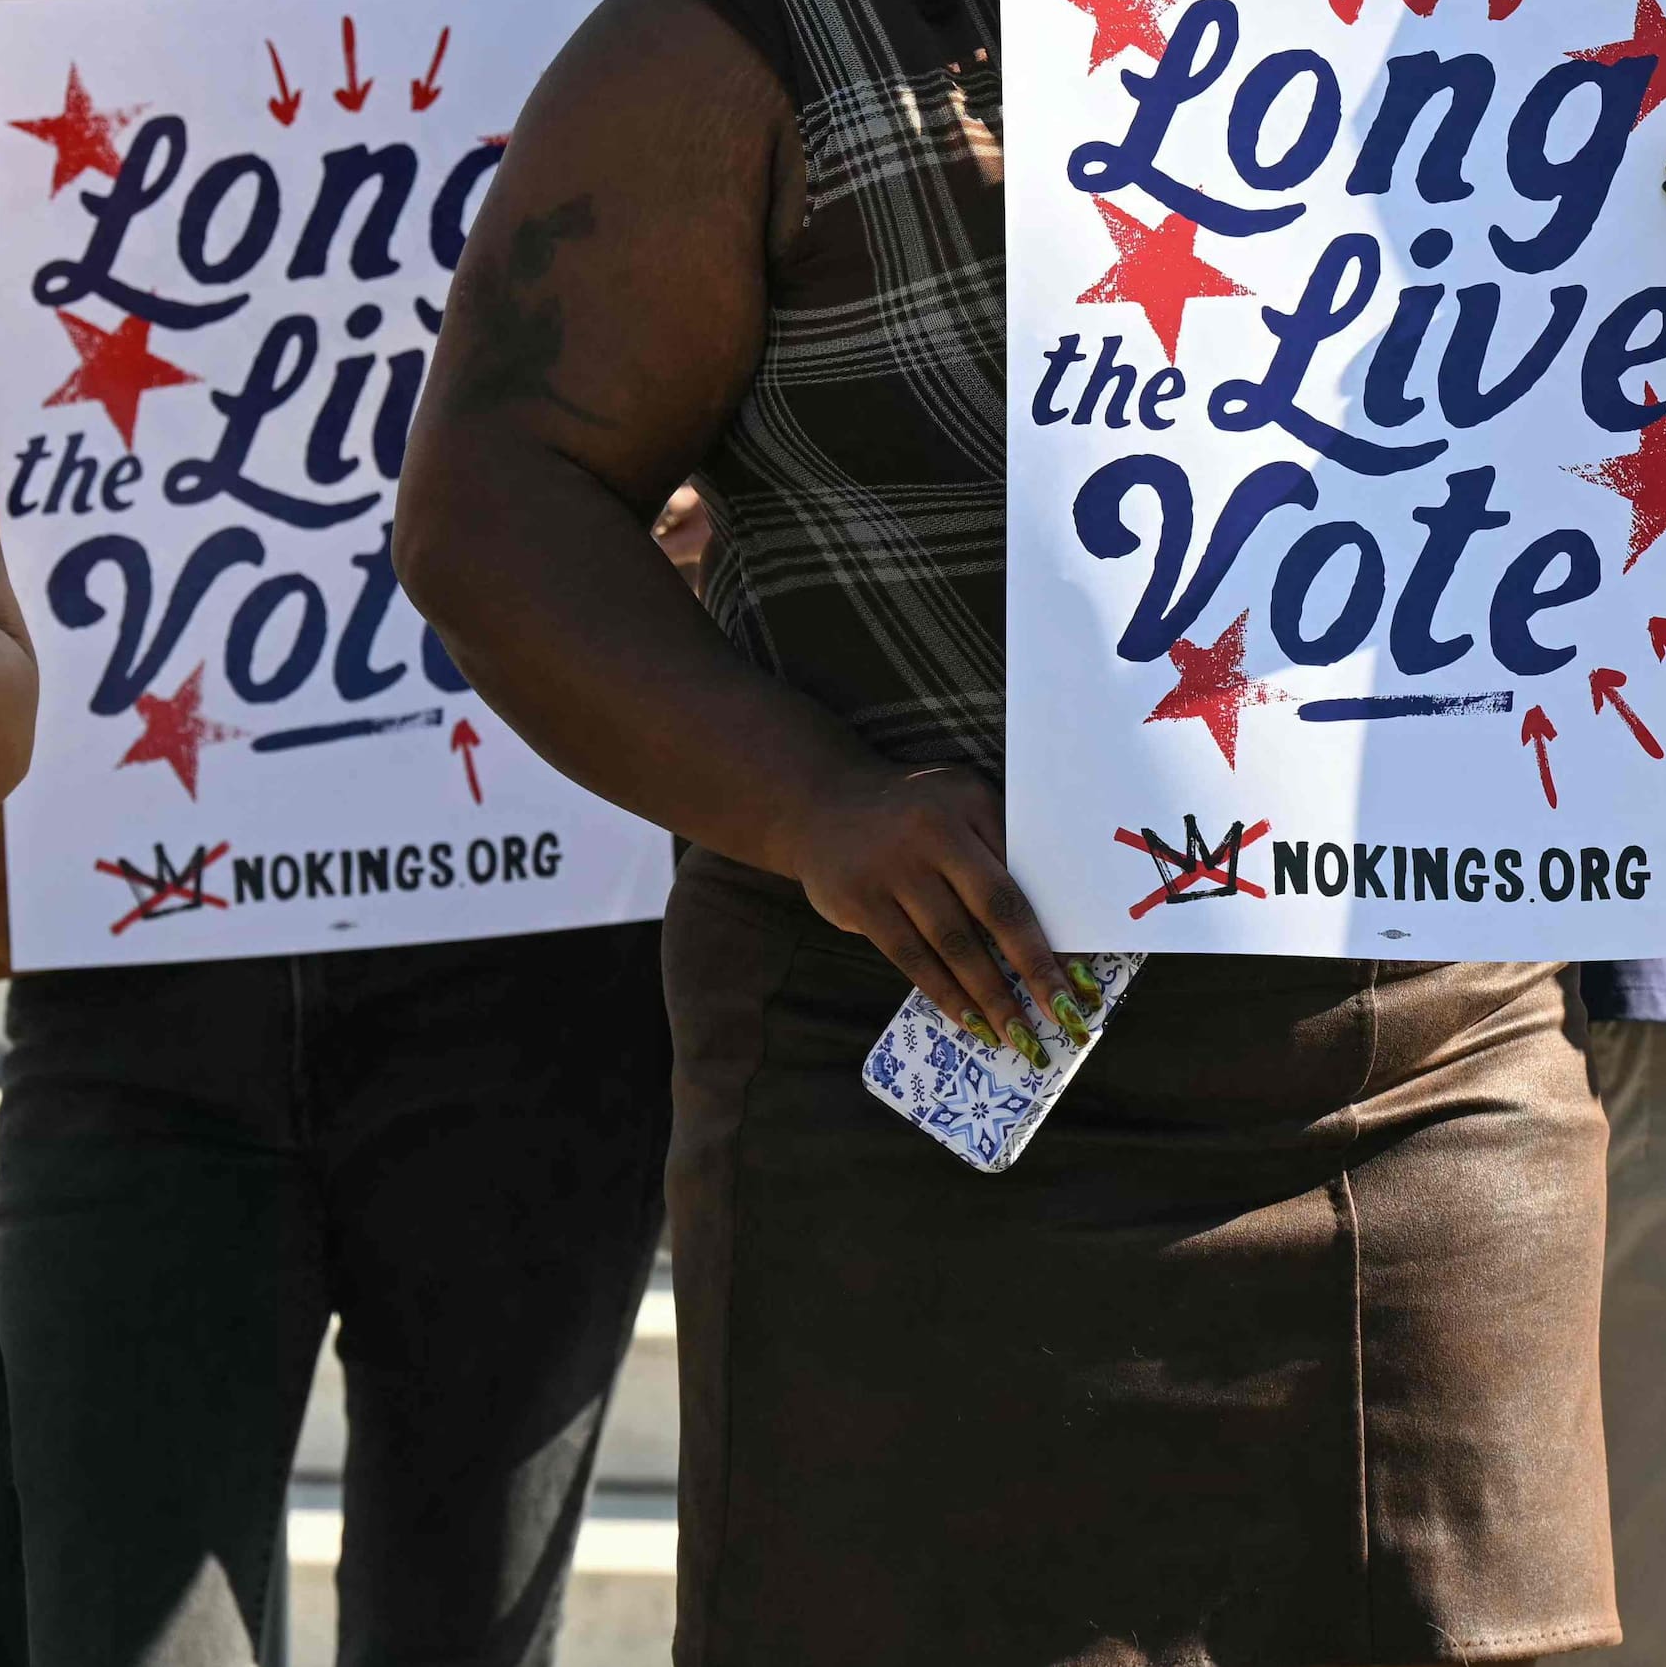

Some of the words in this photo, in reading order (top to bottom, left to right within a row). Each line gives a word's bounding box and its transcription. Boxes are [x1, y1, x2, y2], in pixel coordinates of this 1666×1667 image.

[163, 303, 425, 530] Li
[1031, 333, 1186, 431] the
[6, 432, 143, 519] the
[1072, 453, 1602, 676] Vote
[46, 521, 473, 717] Vot
[232, 833, 563, 905] NOKINGS.ORG
[1272, 840, 1652, 905] NOKINGS.ORG
